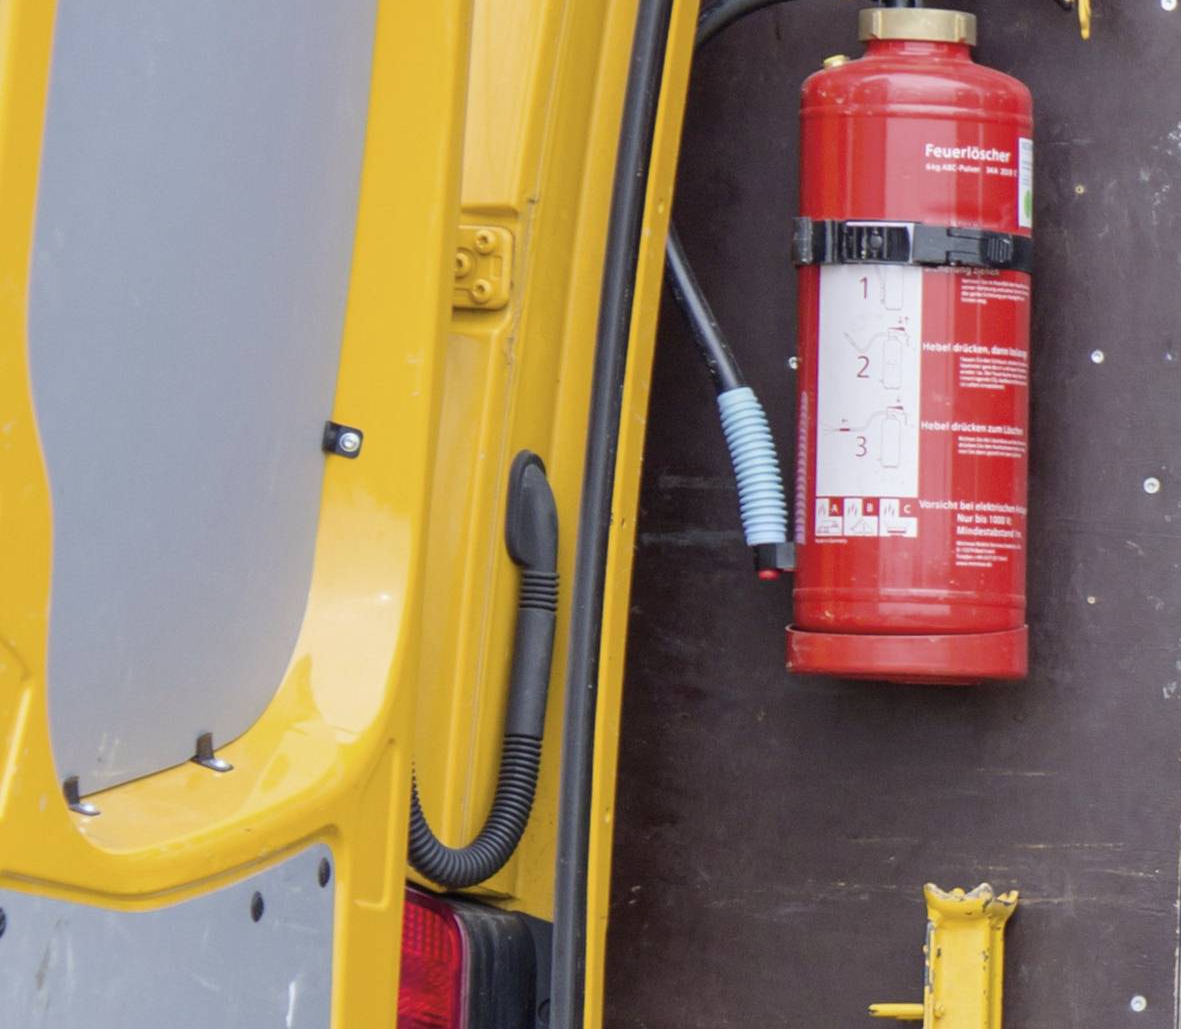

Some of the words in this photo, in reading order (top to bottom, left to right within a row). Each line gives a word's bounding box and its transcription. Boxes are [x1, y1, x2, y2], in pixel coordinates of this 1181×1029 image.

[925, 143, 1011, 164] Feuerlöscher
[859, 276, 868, 299] 1
[922, 343, 951, 353] Hebel
[857, 355, 870, 379] 2
[920, 421, 950, 432] Hebel
[951, 422, 987, 433] drücken
[855, 436, 868, 458] 3
[831, 503, 839, 512] A
[866, 503, 874, 512] B
[903, 504, 912, 514] C
[919, 499, 958, 511] Vorsicht
[959, 500, 974, 511] bei
[957, 513, 973, 523] Nur
[975, 514, 987, 524] bis
